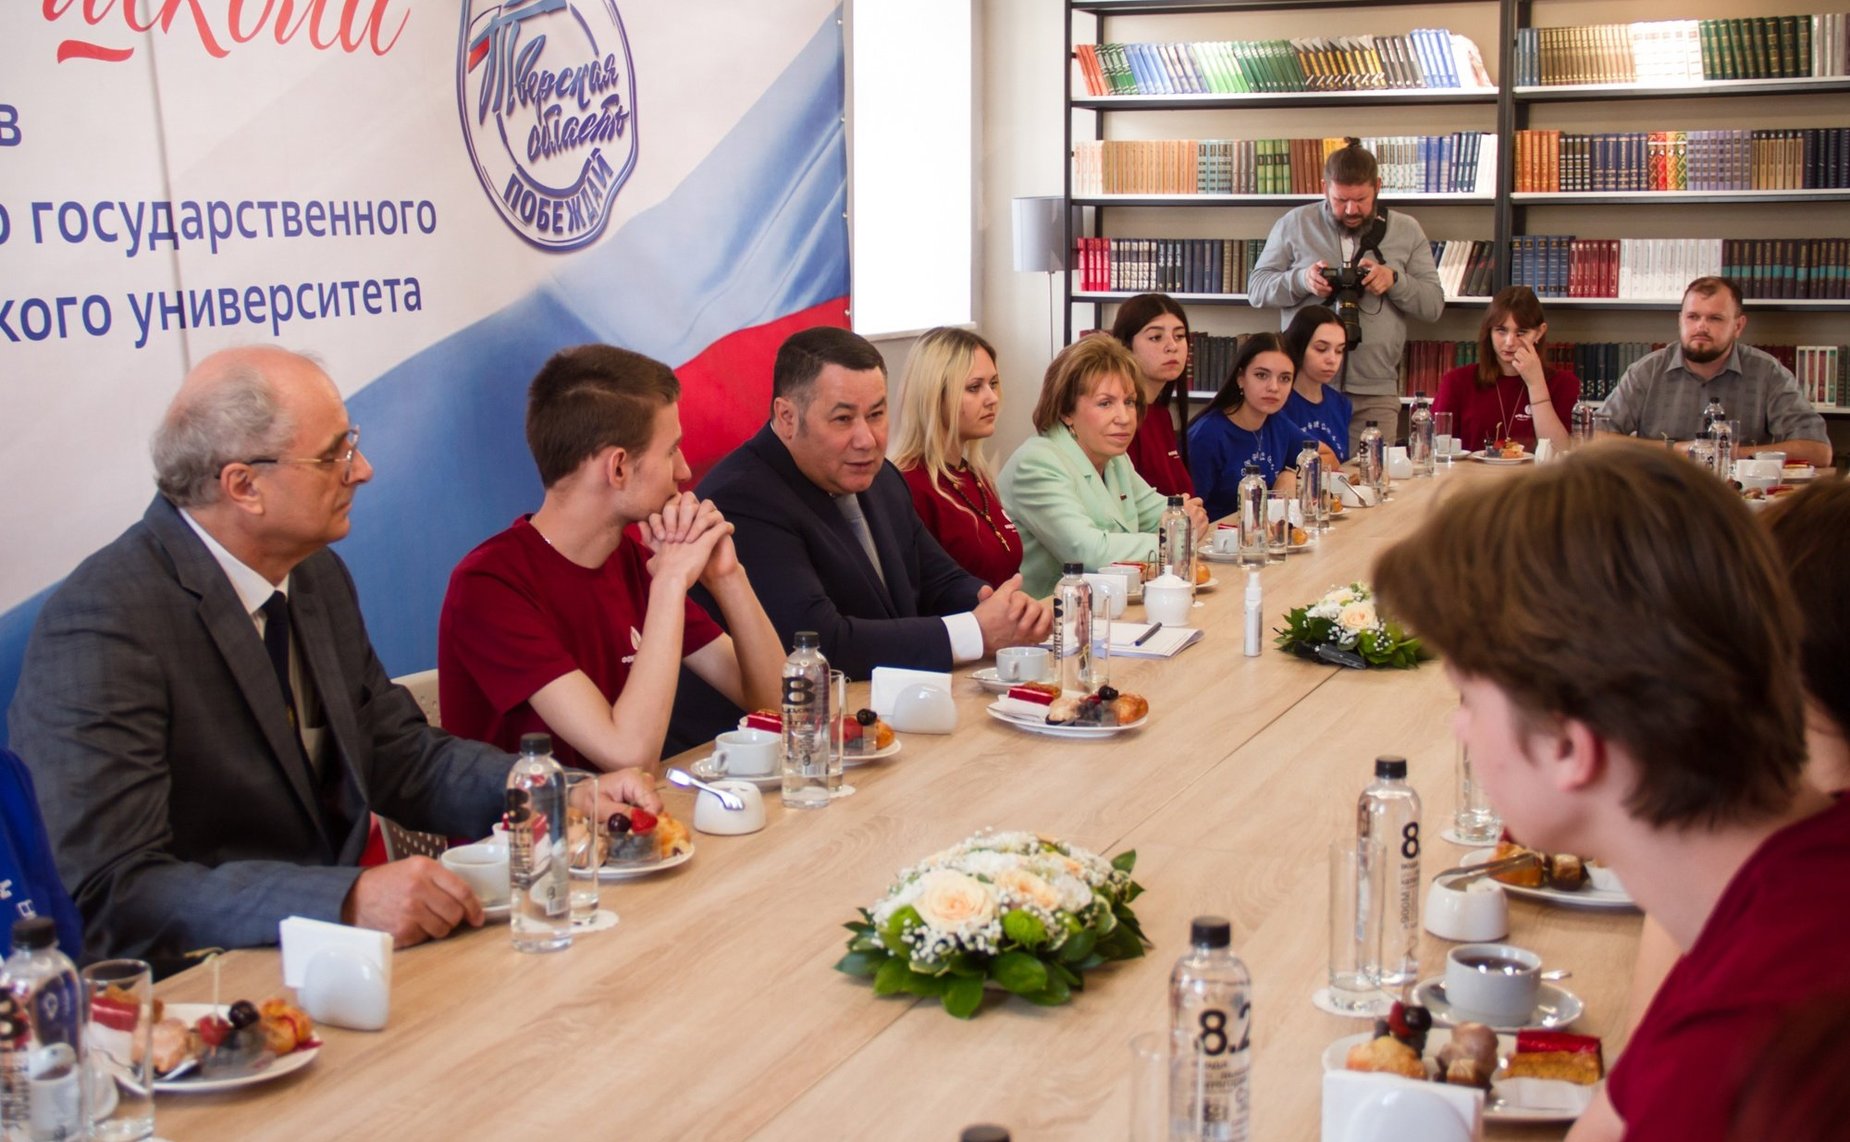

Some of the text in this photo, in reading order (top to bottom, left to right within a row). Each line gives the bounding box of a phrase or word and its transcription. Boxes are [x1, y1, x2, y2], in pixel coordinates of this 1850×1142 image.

[468, 0, 620, 125] Тверская
[526, 93, 630, 164] область
[503, 147, 614, 235] ПОБЕЖДАЙ
[31, 199, 438, 258] государственного
[127, 275, 423, 350] университета
[1401, 821, 1419, 860] 8
